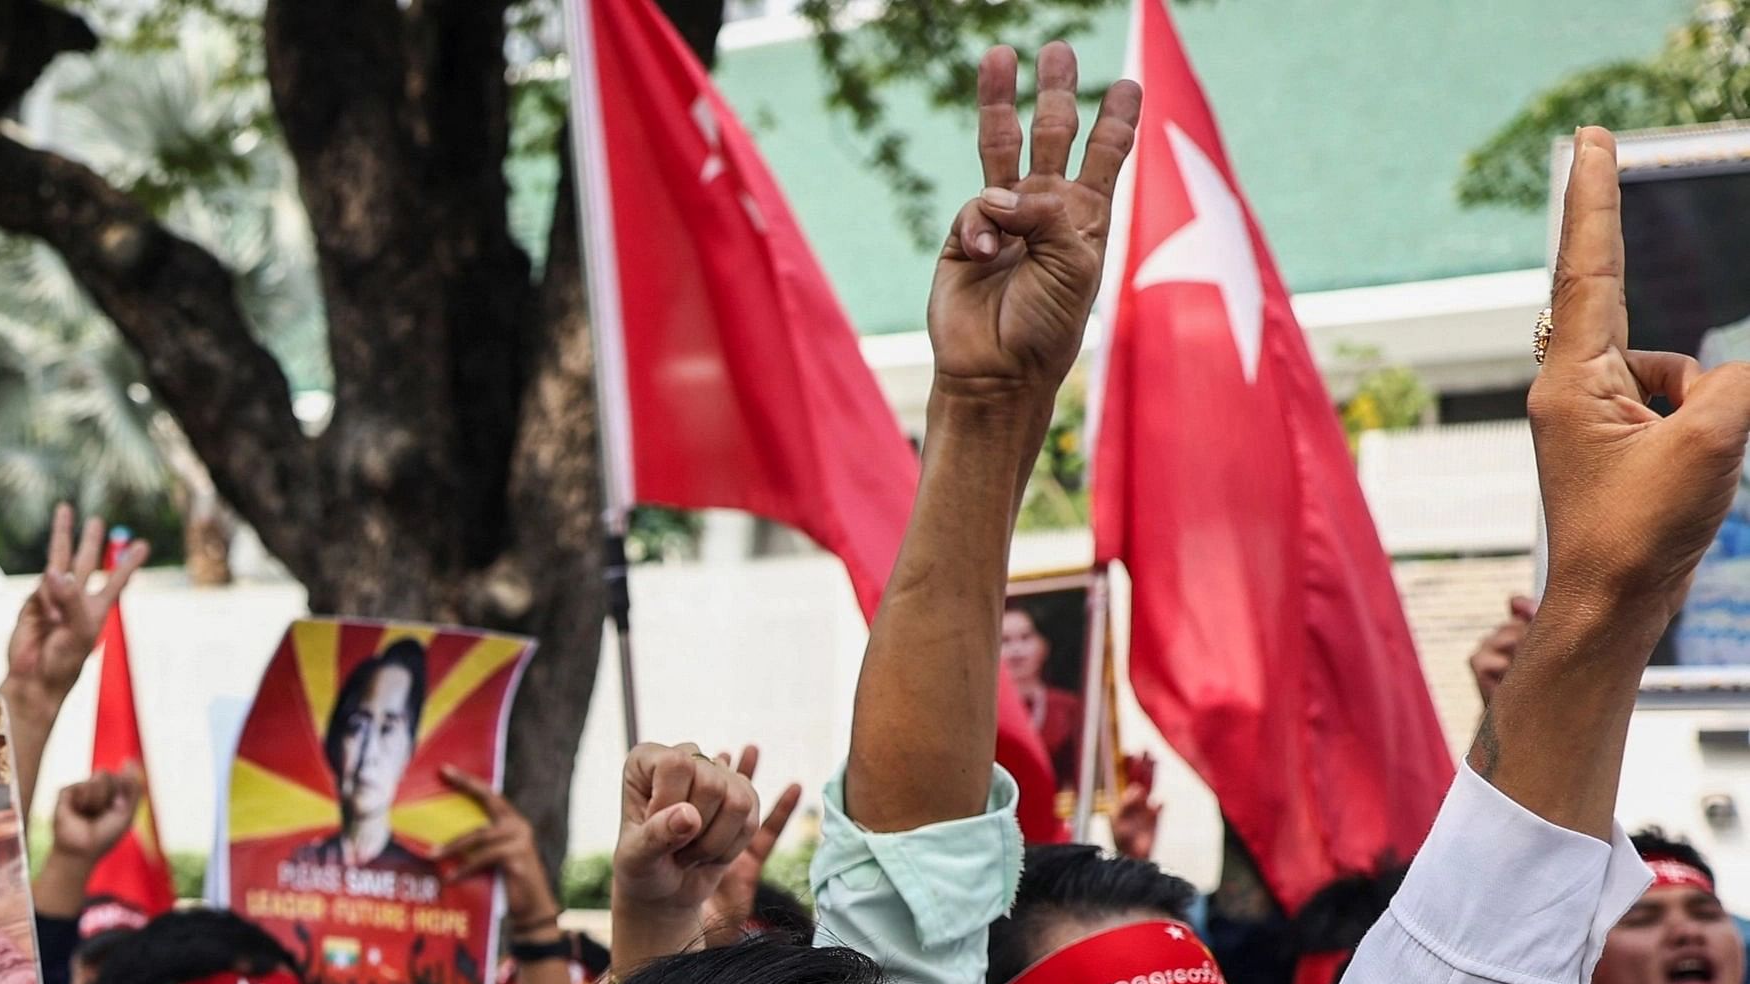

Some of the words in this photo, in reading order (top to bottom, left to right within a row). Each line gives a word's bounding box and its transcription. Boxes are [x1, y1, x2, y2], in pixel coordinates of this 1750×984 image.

[277, 860, 341, 893] PLEASE
[345, 866, 397, 899] SAVE
[399, 872, 440, 903] OUR
[246, 888, 327, 921] LEADER
[331, 896, 406, 932] FUTURE
[413, 906, 469, 938] HOPE
